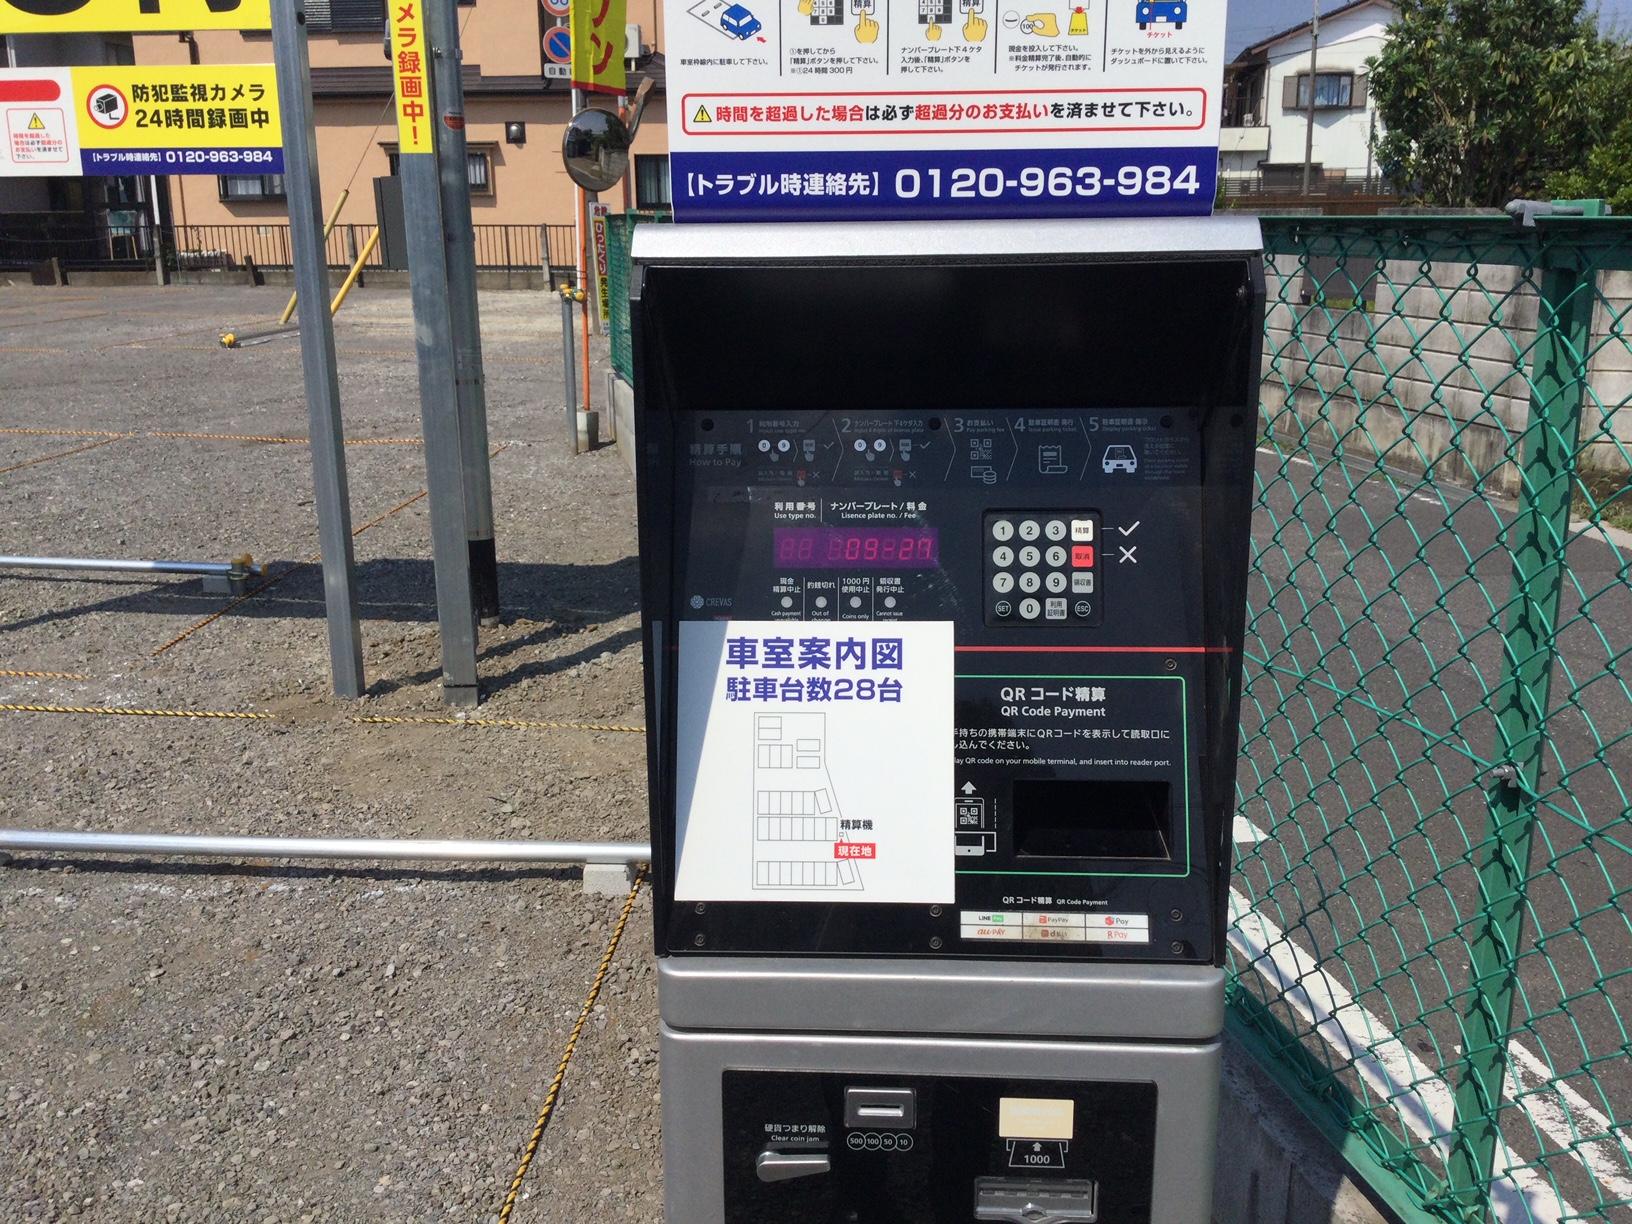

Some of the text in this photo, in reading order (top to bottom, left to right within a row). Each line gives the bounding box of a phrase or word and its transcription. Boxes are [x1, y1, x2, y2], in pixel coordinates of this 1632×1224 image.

[1111, 47, 1206, 55] チケットを外から見えるように
[548, 66, 571, 76] 自動
[901, 65, 944, 73] 押して下さい。
[131, 84, 265, 103] 防犯監視カメラ
[716, 102, 1192, 122] 時間を超過した場合は必ず超過分のお支払いを済ませて下さい。
[135, 108, 270, 129] 24時間録画中
[166, 150, 273, 163] 0120-963-984
[688, 166, 1199, 198] 【トラブル時連絡先】 0120-963-984
[746, 418, 753, 433] 1
[842, 418, 851, 432] 2
[954, 418, 964, 432] 3
[1014, 418, 1025, 432] 4
[1090, 417, 1099, 431] 5
[725, 458, 741, 467] Pay
[774, 502, 816, 510] 利用番号
[830, 502, 898, 510] ナンバープレート
[906, 502, 926, 510] 料金
[1000, 526, 1005, 535] 1
[1026, 526, 1032, 535] 2
[1053, 526, 1059, 535] 3
[1000, 552, 1006, 561] 4
[1026, 552, 1032, 561] 5
[1053, 552, 1059, 561] 6
[1000, 578, 1006, 587] 7
[1026, 578, 1033, 587] 8
[1053, 578, 1060, 587] 9
[706, 598, 732, 606] CREVAS
[1026, 604, 1033, 613] 0
[726, 637, 903, 670] 車室案内図
[726, 677, 903, 702] 駐車台数28台
[1001, 706, 1106, 718] QR Code Payment
[840, 820, 872, 830] 精算機
[838, 846, 872, 856] 現在地
[764, 1124, 825, 1133] 硬貨つまり解除
[1024, 1155, 1050, 1165] 1000
